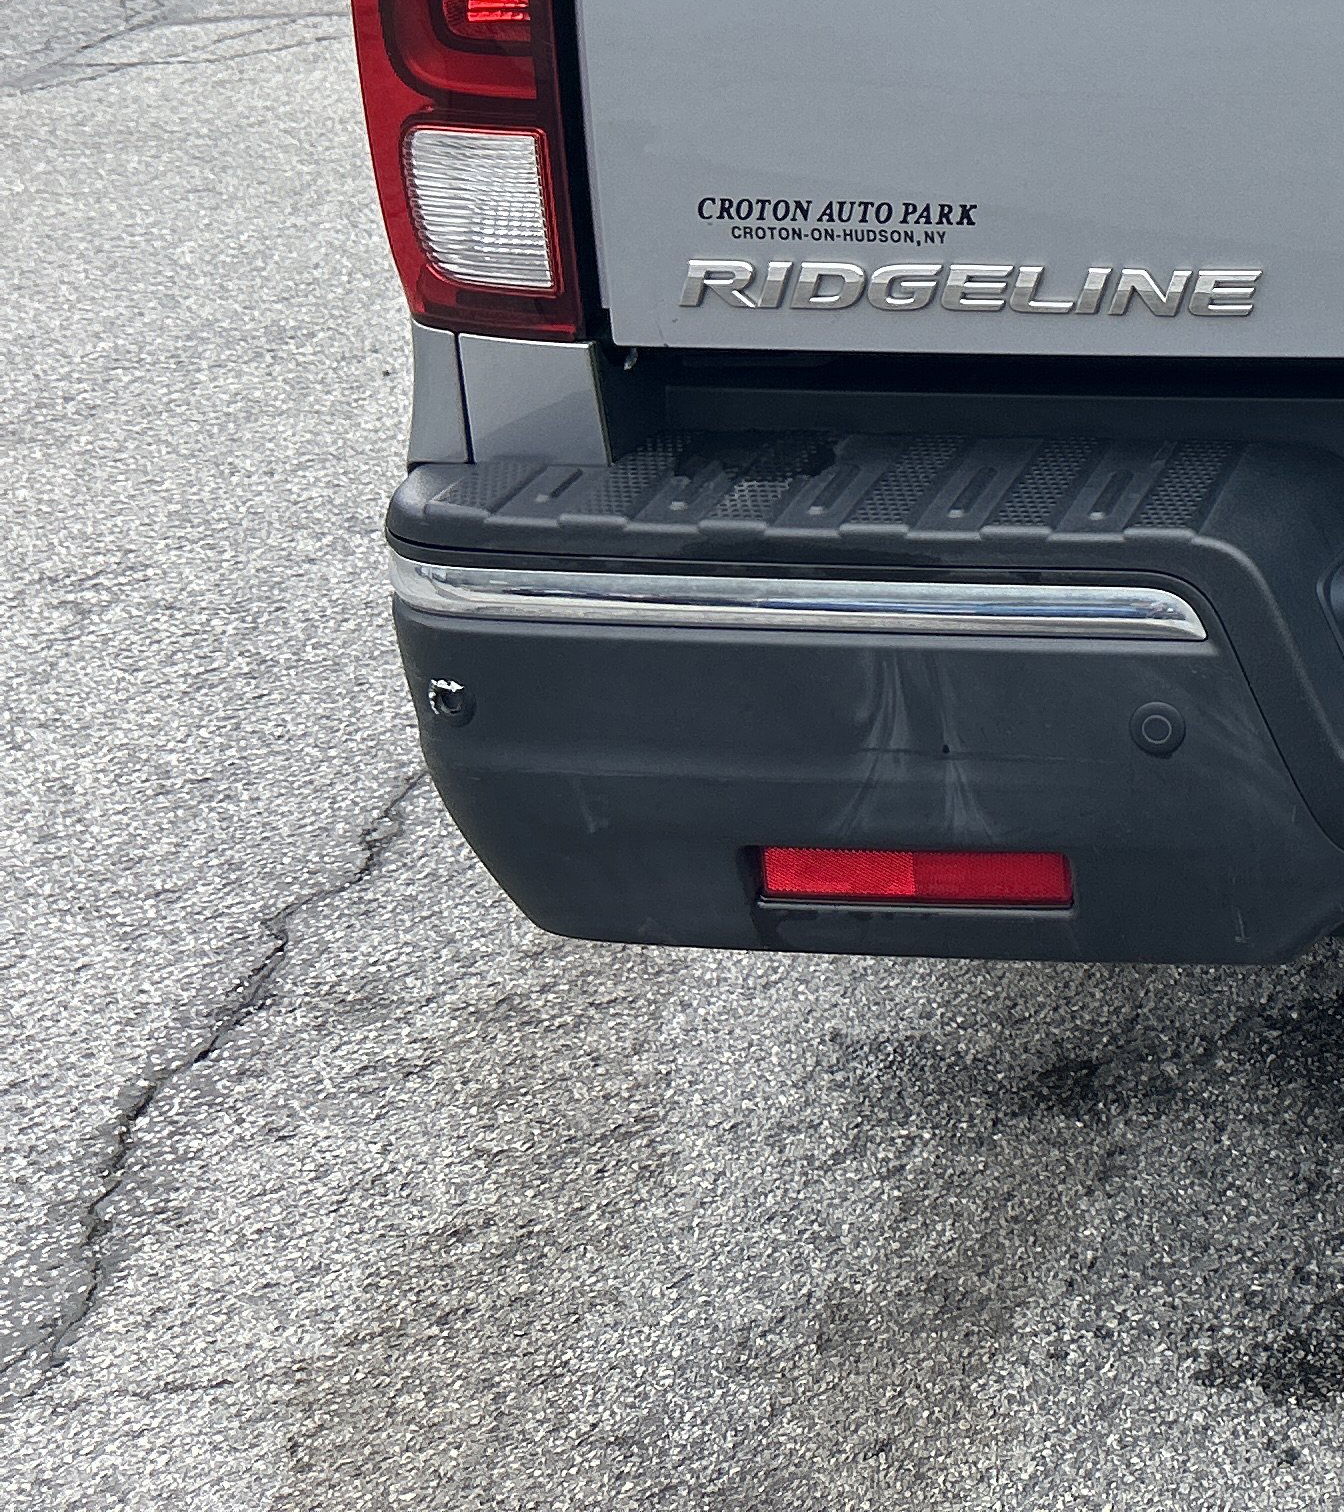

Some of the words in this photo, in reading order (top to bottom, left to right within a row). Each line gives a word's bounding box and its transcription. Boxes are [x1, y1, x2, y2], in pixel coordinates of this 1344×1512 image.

[697, 197, 813, 222] CROTON
[816, 200, 893, 225] AUTO
[899, 202, 978, 227] PARK
[731, 225, 946, 246] CROTON-ON-HUDSON,NY
[678, 258, 1263, 318] RIDGELINE
